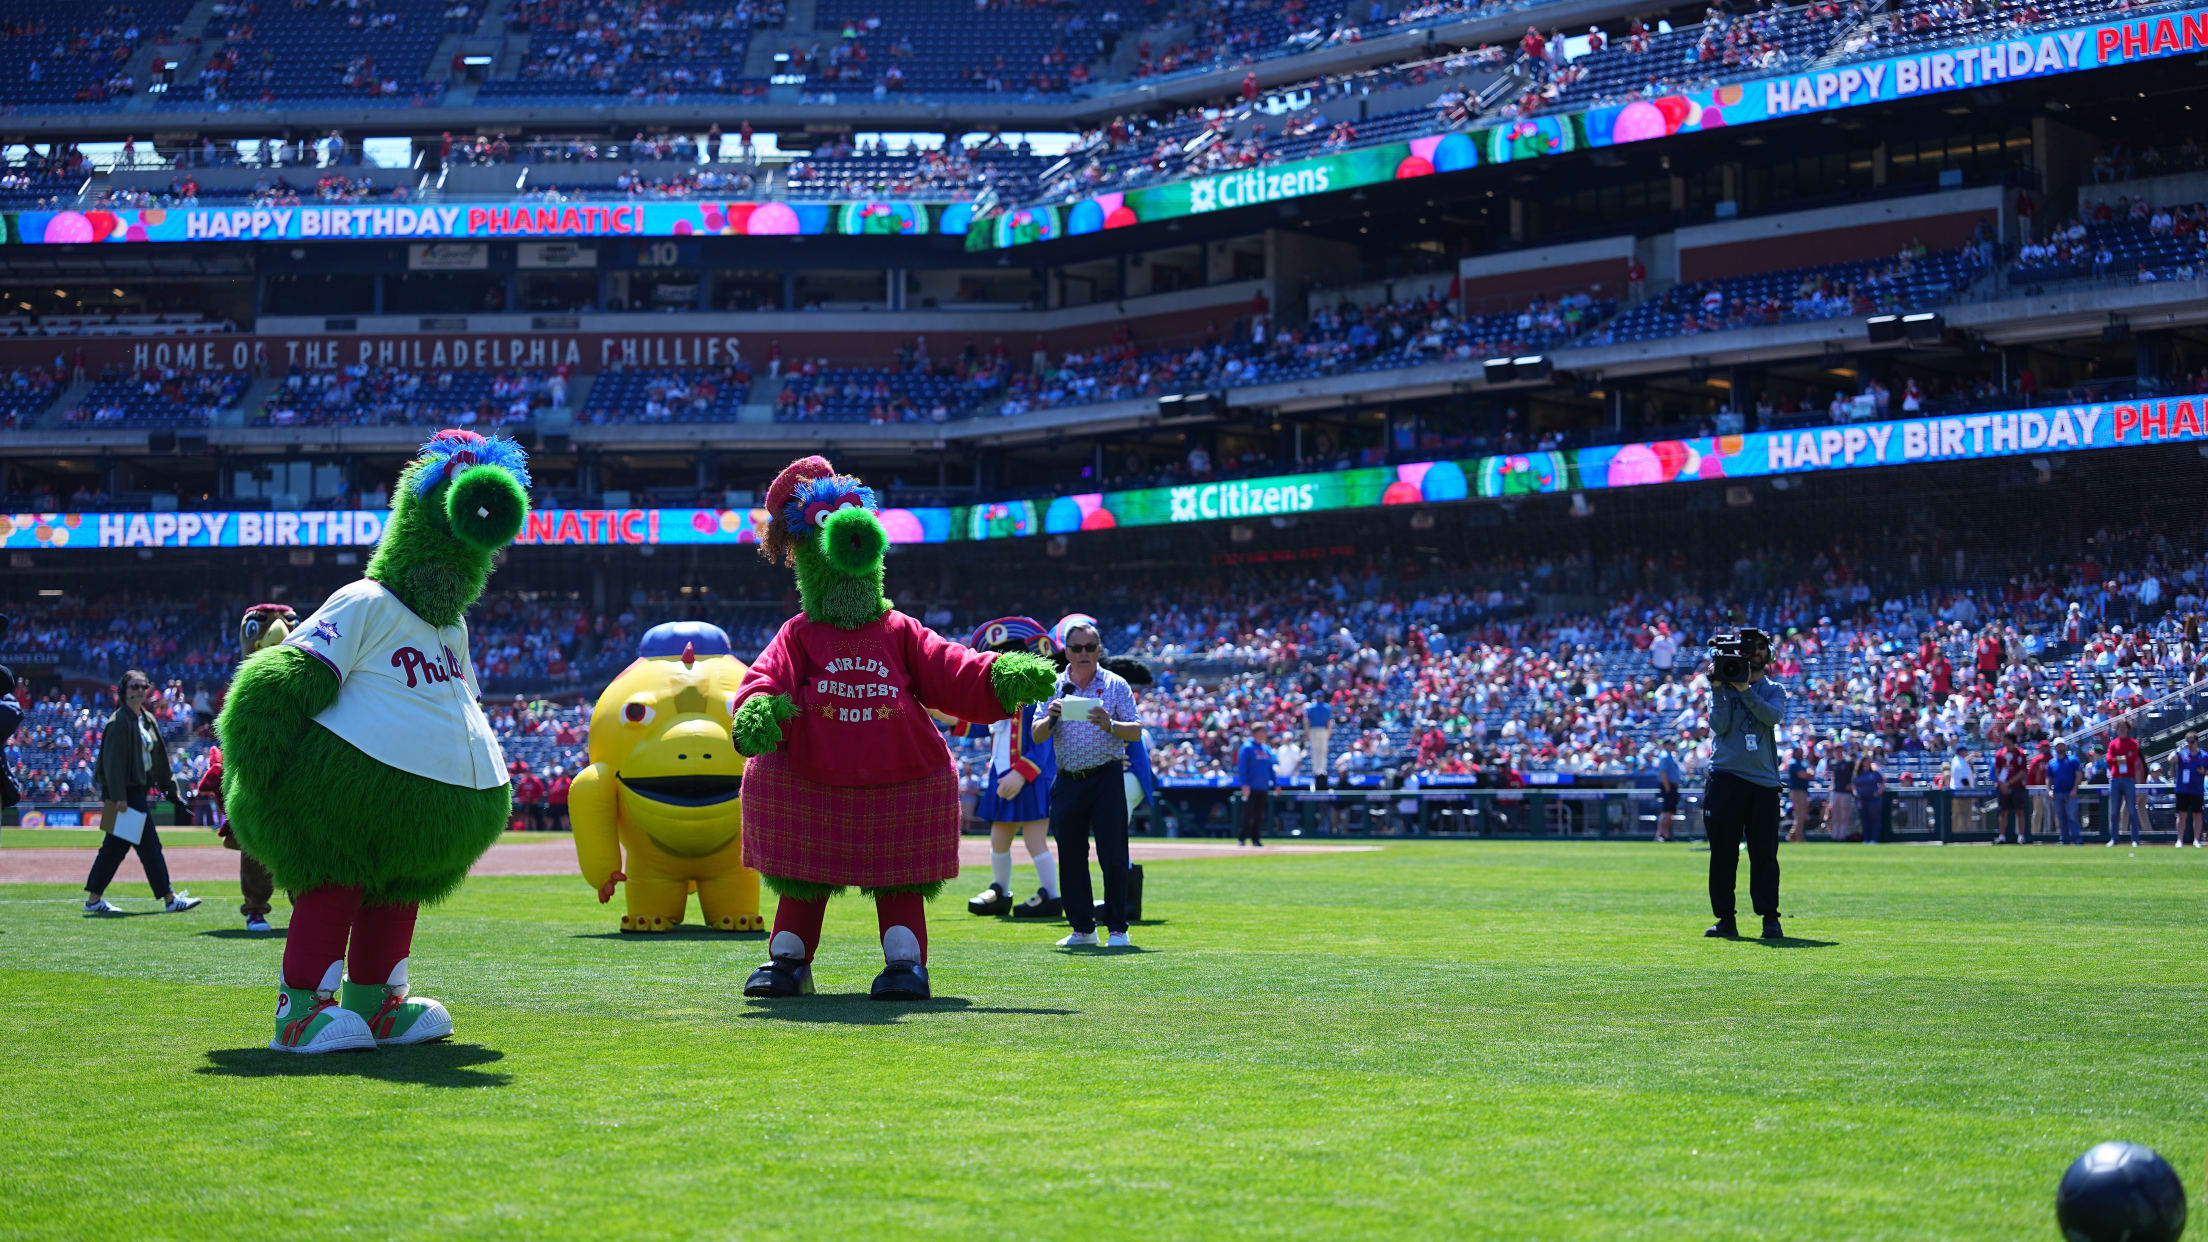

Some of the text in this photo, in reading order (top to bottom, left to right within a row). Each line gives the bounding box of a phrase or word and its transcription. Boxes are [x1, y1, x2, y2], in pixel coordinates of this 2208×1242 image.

[1766, 65, 1886, 114] HAPPY
[1896, 30, 2086, 95] BIRTHDAY
[1218, 166, 1330, 207] Citizens
[187, 205, 645, 238] HAPPY BIRTHDAY PHANATIC!
[133, 342, 216, 371] HOME
[285, 340, 339, 369] THE
[359, 338, 581, 369] PHILADELPHIA
[1767, 425, 1893, 469] HAPPY
[1903, 407, 2102, 459] BIRTHDAY
[1200, 482, 1314, 518] Citizens
[100, 509, 660, 547] HAPPY BIRTHD NATIC!
[825, 656, 890, 678] WORLD'S
[817, 680, 899, 698] GREATEST
[839, 707, 873, 722] MOM
